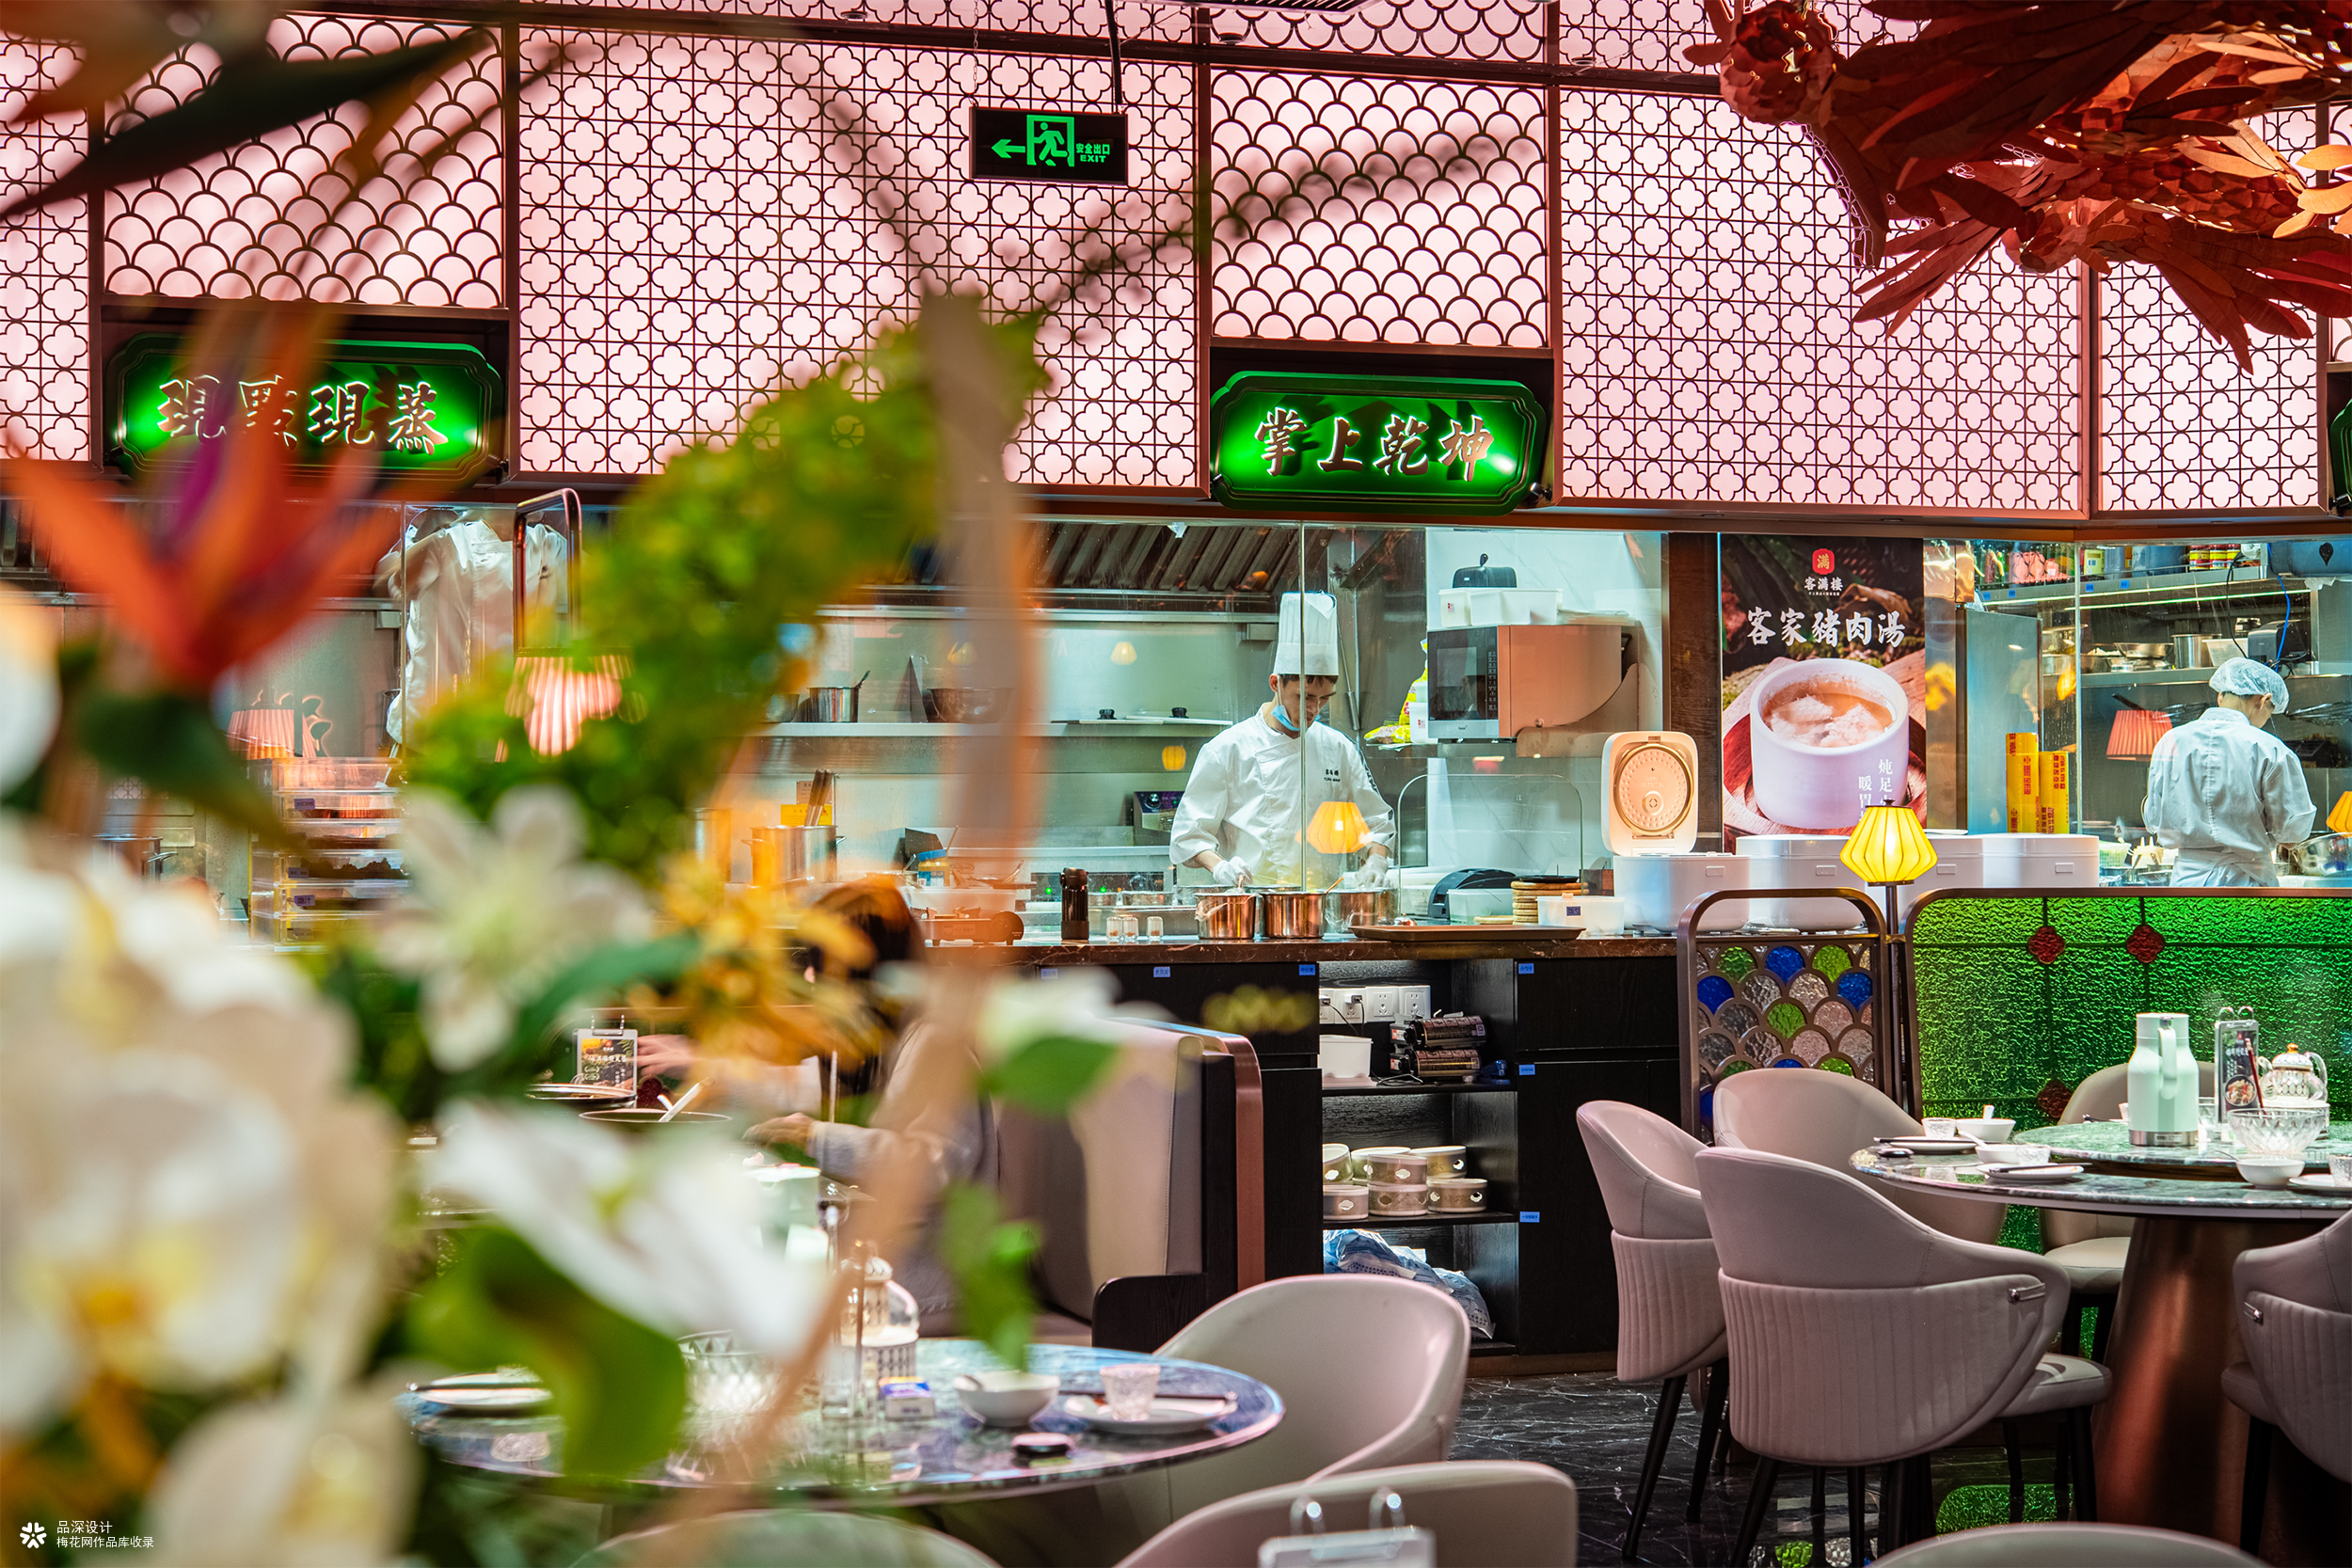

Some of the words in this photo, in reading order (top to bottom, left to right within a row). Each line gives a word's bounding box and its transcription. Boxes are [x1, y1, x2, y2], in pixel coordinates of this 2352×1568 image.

[1075, 143, 1110, 155] 安全出口
[1080, 154, 1106, 163] EXIT
[1254, 406, 1495, 482] 掌上乾坤
[1747, 606, 1907, 649] 客家豬肉湯
[1858, 775, 1873, 822] 暖胃
